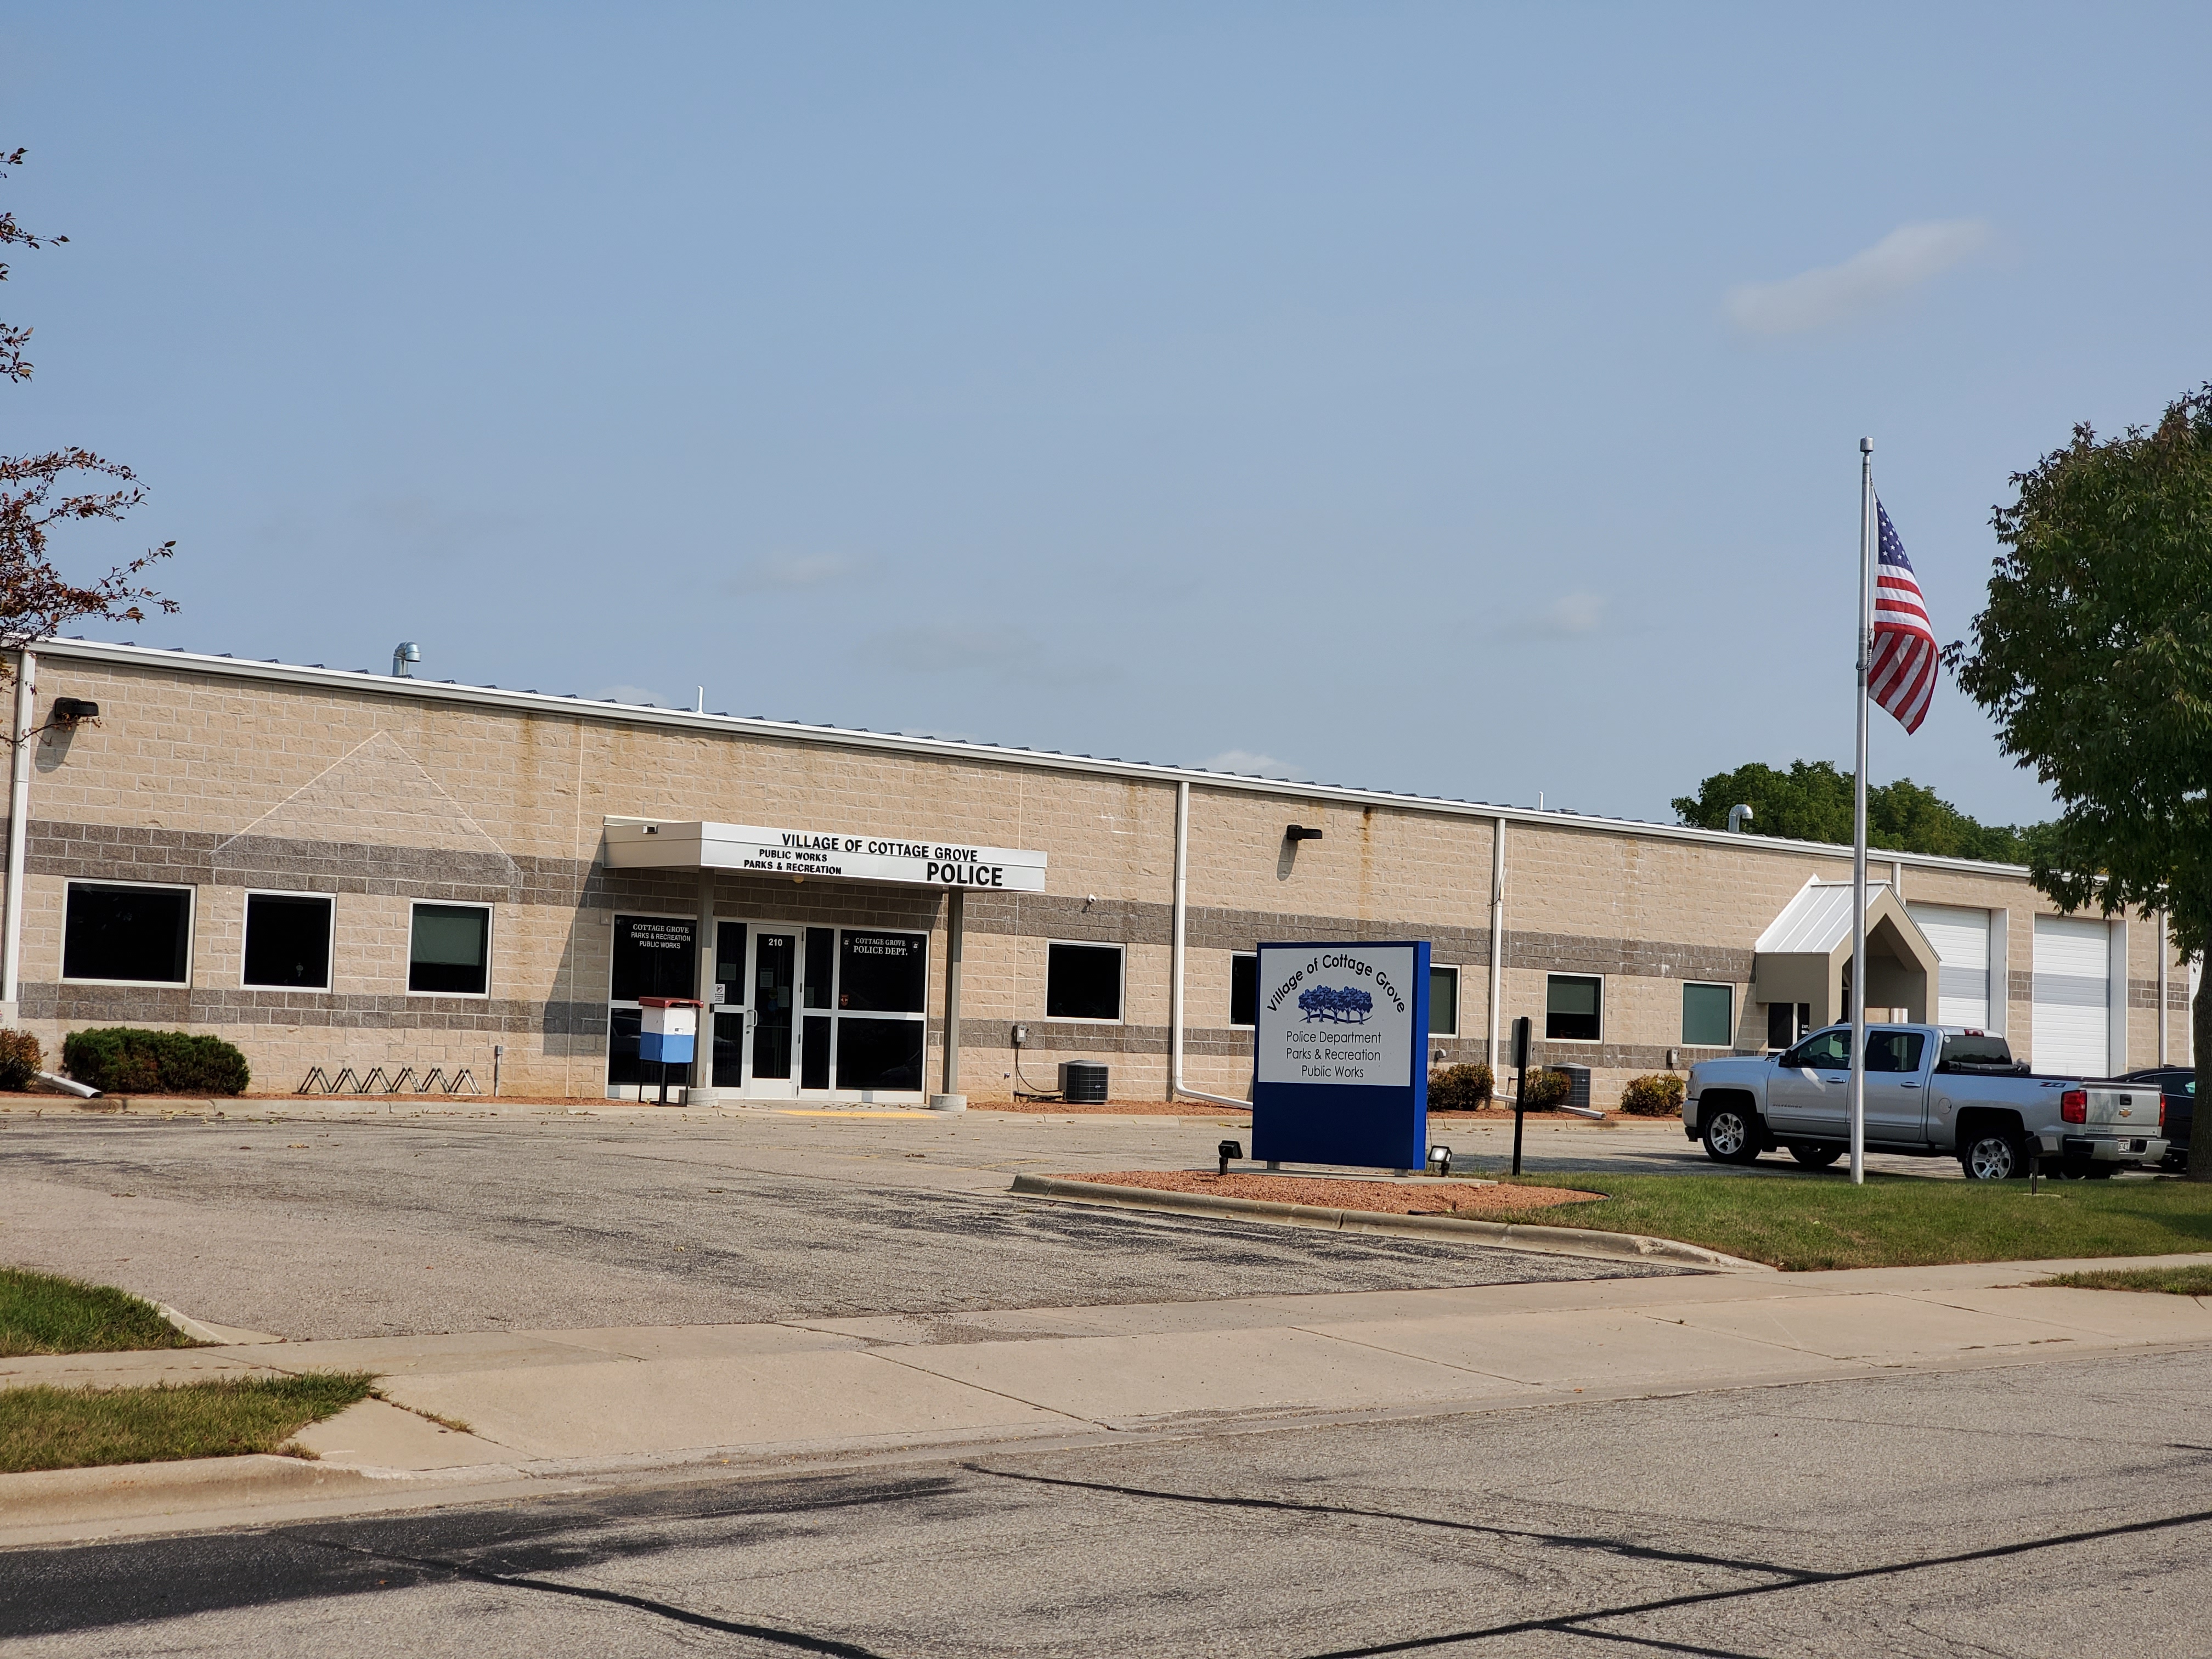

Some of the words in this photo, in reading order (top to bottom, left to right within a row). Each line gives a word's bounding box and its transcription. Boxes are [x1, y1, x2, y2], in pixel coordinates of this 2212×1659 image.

[782, 833, 839, 850] VILLAGE
[845, 839, 863, 852] OF
[868, 841, 929, 857] COTTAGE
[934, 847, 978, 862] GROVE
[759, 849, 792, 859] PUBLIC
[795, 852, 827, 862] WORKS
[744, 860, 773, 869] PARKS
[776, 862, 783, 870] &
[786, 863, 842, 874] RECREATION
[927, 862, 1003, 887] POLICE
[656, 933, 691, 941] RECREATION
[768, 938, 783, 946] 210
[853, 945, 883, 954] POLICE
[885, 947, 908, 956] DEPT.
[1267, 970, 1304, 1012] Village
[1307, 957, 1318, 974] of
[1322, 953, 1372, 976] Cottage
[1376, 972, 1405, 1013] Grove
[1286, 1030, 1316, 1042] Police
[1319, 1031, 1381, 1046] Department
[1286, 1048, 1311, 1059] Parks
[1314, 1048, 1322, 1060] &
[1325, 1048, 1380, 1061] Recreation
[1302, 1065, 1331, 1077] Public
[1335, 1066, 1364, 1078] Works
